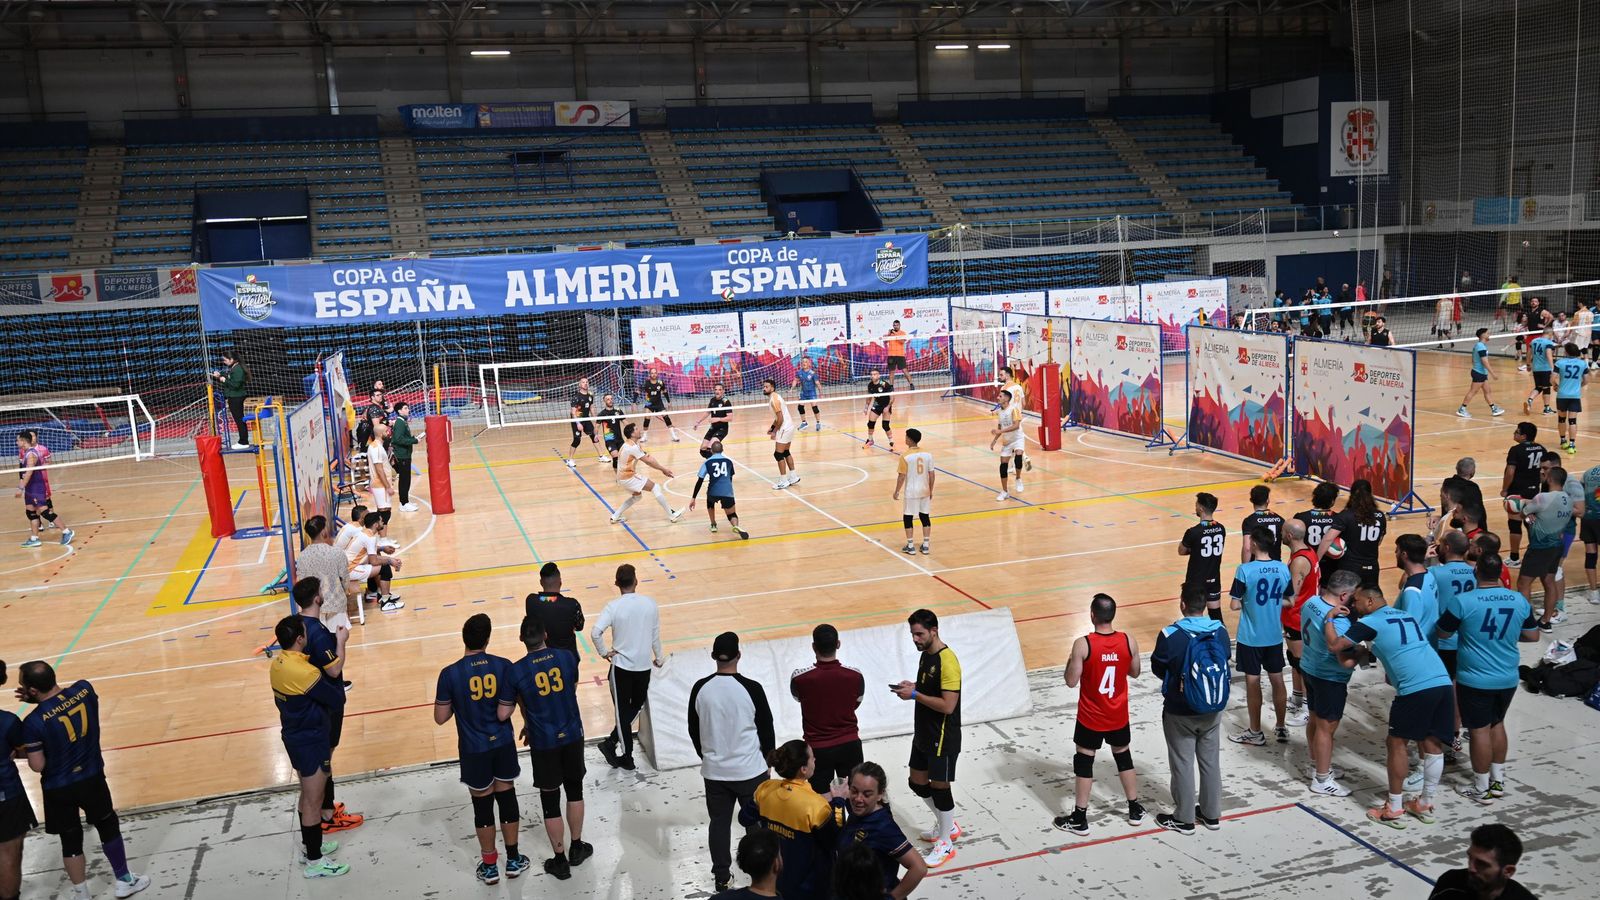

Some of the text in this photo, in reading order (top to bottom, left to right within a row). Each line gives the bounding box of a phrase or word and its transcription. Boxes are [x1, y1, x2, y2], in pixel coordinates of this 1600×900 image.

[412, 106, 462, 118] molten
[728, 246, 798, 265] COPA de
[104, 275, 152, 285] DEPORTES
[333, 266, 416, 286] COPA de
[505, 254, 679, 308] ALMERÍA
[710, 258, 848, 296] ESPAÑA
[0, 283, 33, 291] ORTES
[237, 285, 268, 294] ESPAÑA
[230, 291, 277, 309] Voleibol
[314, 278, 475, 319] ESPAÑA
[1129, 340, 1152, 348] DEPORTES
[1204, 342, 1230, 355] ALMERÍA
[1533, 342, 1543, 355] 14
[1251, 352, 1277, 362] DEPORTES
[1258, 360, 1280, 369] ALMERIA
[1313, 358, 1344, 371] ALMERÍA
[1369, 370, 1401, 380] DEPORTES
[1564, 364, 1580, 379] 52
[1369, 377, 1404, 389] DE ALMERIA
[916, 457, 924, 475] 6
[1527, 451, 1543, 470] 14
[712, 461, 728, 478] 34
[1561, 496, 1568, 506] 3
[1200, 534, 1224, 558] 33
[1255, 577, 1282, 607] 84
[1477, 594, 1516, 603] MACHADO
[1307, 601, 1322, 617] SERGIO
[1385, 617, 1424, 645] 77
[1480, 607, 1515, 641] 47
[1101, 652, 1119, 662] RAÚL
[469, 673, 497, 701] 99
[534, 666, 564, 696] 93
[1098, 665, 1116, 699] 4
[41, 688, 89, 721] ALMUDEVER
[58, 702, 88, 743] 17
